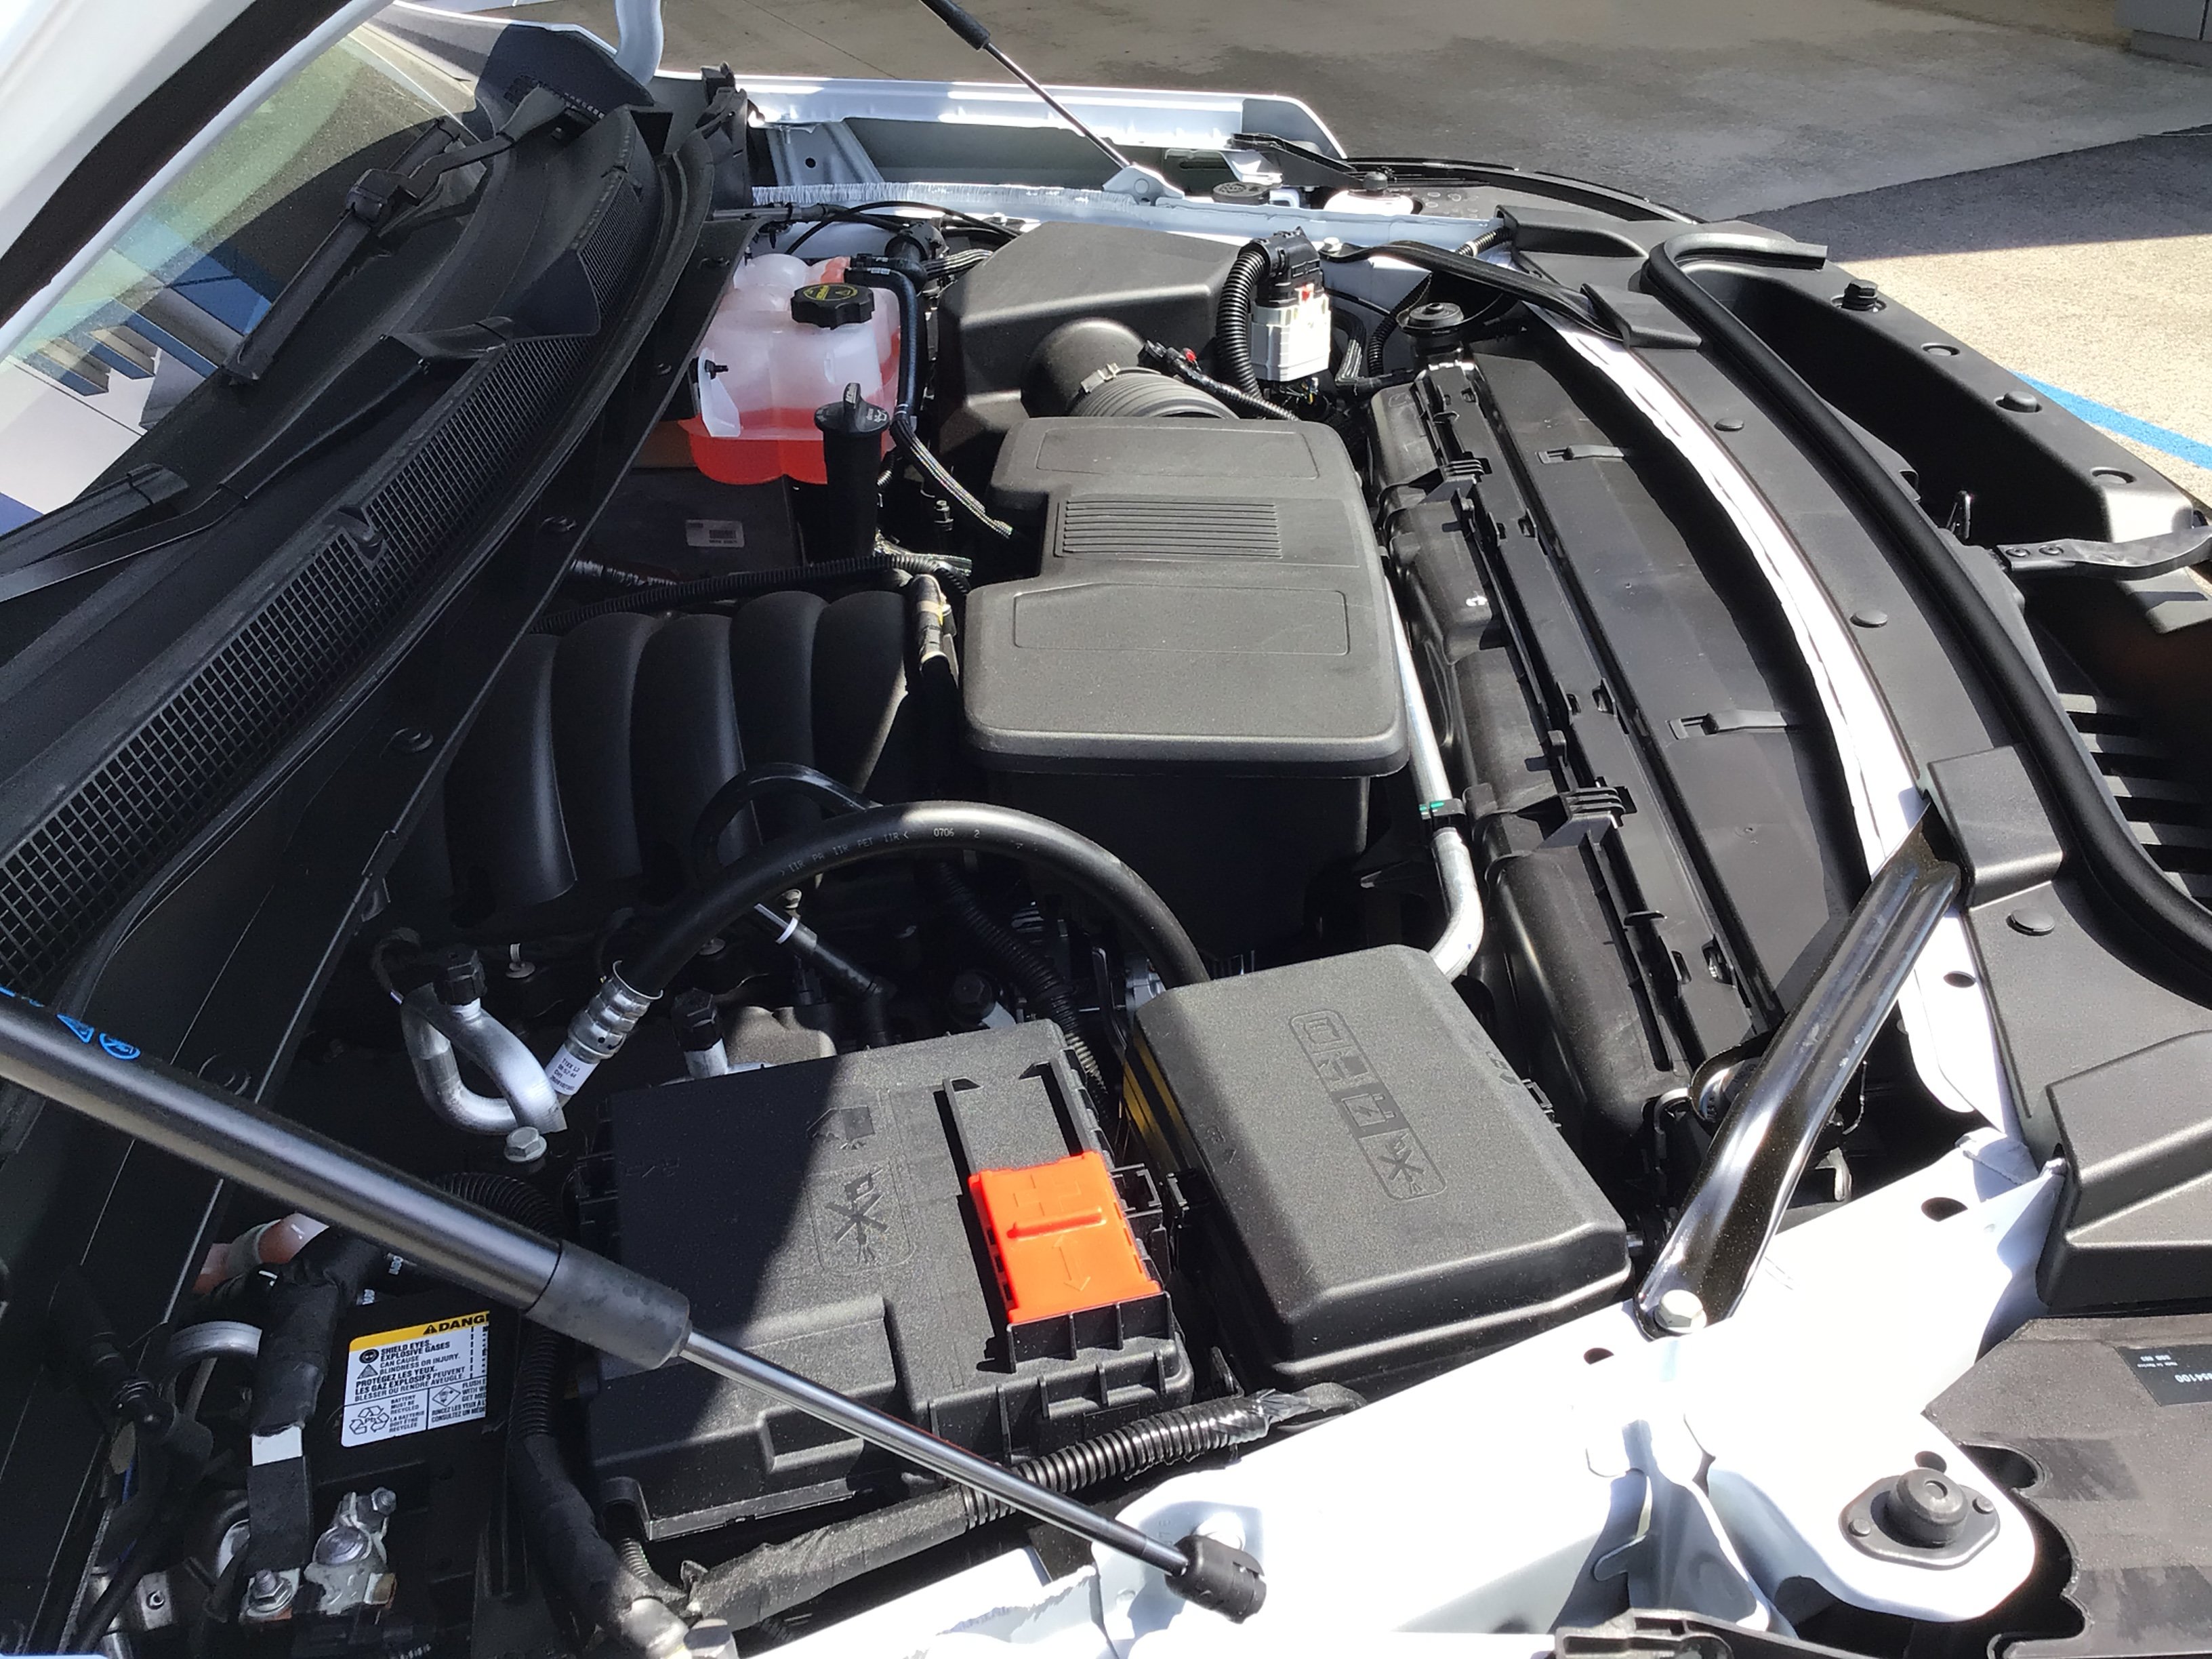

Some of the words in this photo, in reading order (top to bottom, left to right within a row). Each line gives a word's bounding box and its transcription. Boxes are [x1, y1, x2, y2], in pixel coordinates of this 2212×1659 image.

[832, 845, 850, 855] IIR
[857, 838, 873, 847] PET
[974, 830, 980, 838] 2
[439, 1314, 488, 1332] DANG
[381, 1347, 423, 1361] EXPLOSIVE
[426, 1342, 450, 1353] GASES
[382, 1345, 407, 1355] SHIELD
[410, 1340, 432, 1349] EYES.
[380, 1362, 419, 1374] BLINDNESS
[433, 1353, 460, 1364] INJURY.
[396, 1355, 418, 1364] CAUSE
[355, 1387, 369, 1395] LES
[371, 1382, 387, 1391] GAZ
[389, 1374, 431, 1387] EXPLOSIFS
[434, 1366, 465, 1378] PEUVENT
[356, 1374, 398, 1387] PROTÉGEZ
[398, 1370, 411, 1378] LES
[415, 1366, 437, 1374] YEUX.
[462, 1380, 481, 1389] FLUSH
[355, 1390, 386, 1401] BLESSER
[401, 1381, 428, 1391] RENDRE
[391, 1395, 415, 1404] BATTERY
[390, 1405, 419, 1414] RECYCLED
